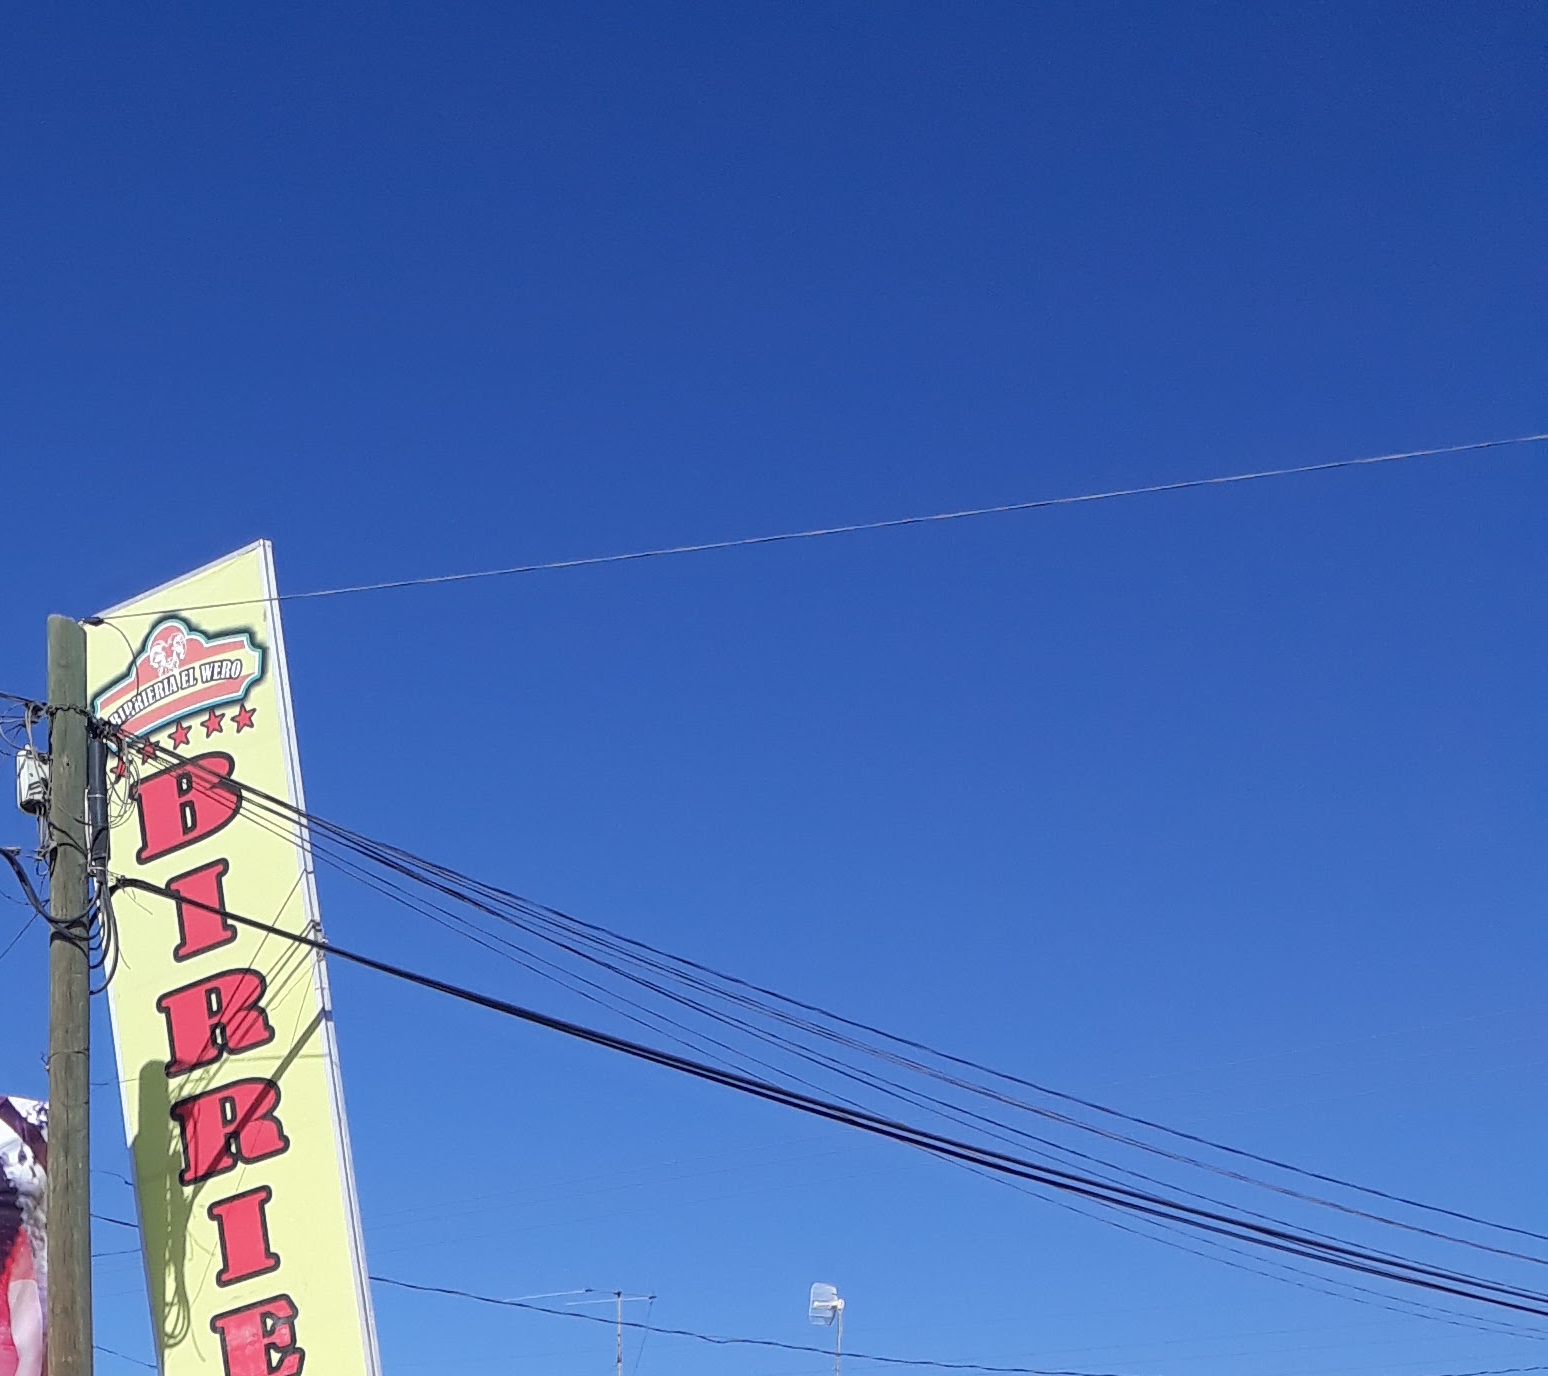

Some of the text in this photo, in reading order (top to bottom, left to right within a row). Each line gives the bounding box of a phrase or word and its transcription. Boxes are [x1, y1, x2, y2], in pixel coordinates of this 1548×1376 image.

[108, 659, 243, 725] BIRRIERIA EL WERO
